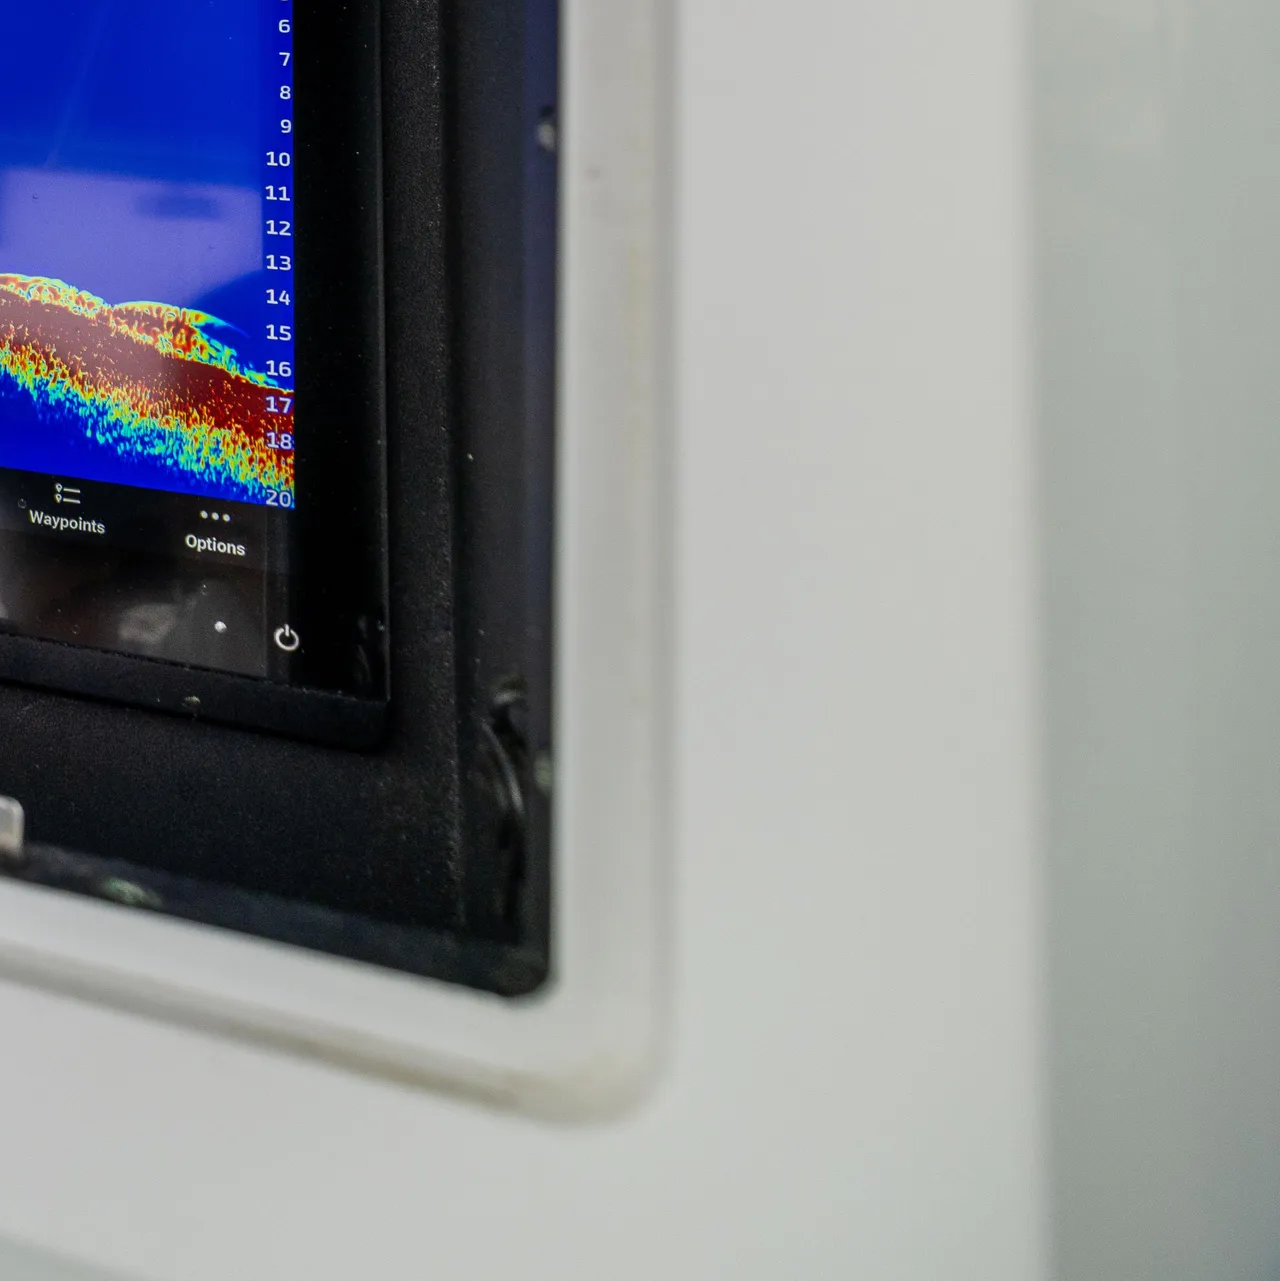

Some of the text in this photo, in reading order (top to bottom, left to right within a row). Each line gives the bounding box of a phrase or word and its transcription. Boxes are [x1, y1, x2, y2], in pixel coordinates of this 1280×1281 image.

[278, 19, 291, 33] 6
[278, 51, 291, 66] 7
[279, 85, 291, 100] 8
[280, 119, 292, 133] 9
[266, 151, 291, 167] 10
[265, 185, 291, 201] 11
[265, 219, 291, 236] 12
[265, 254, 292, 271] 13
[265, 289, 291, 306] 14
[265, 324, 292, 341] 15
[265, 360, 292, 377] 16
[265, 396, 292, 414] 17
[266, 432, 292, 450] 18
[265, 489, 292, 508] 20
[29, 509, 106, 535] Waypoints
[185, 534, 246, 556] Options
